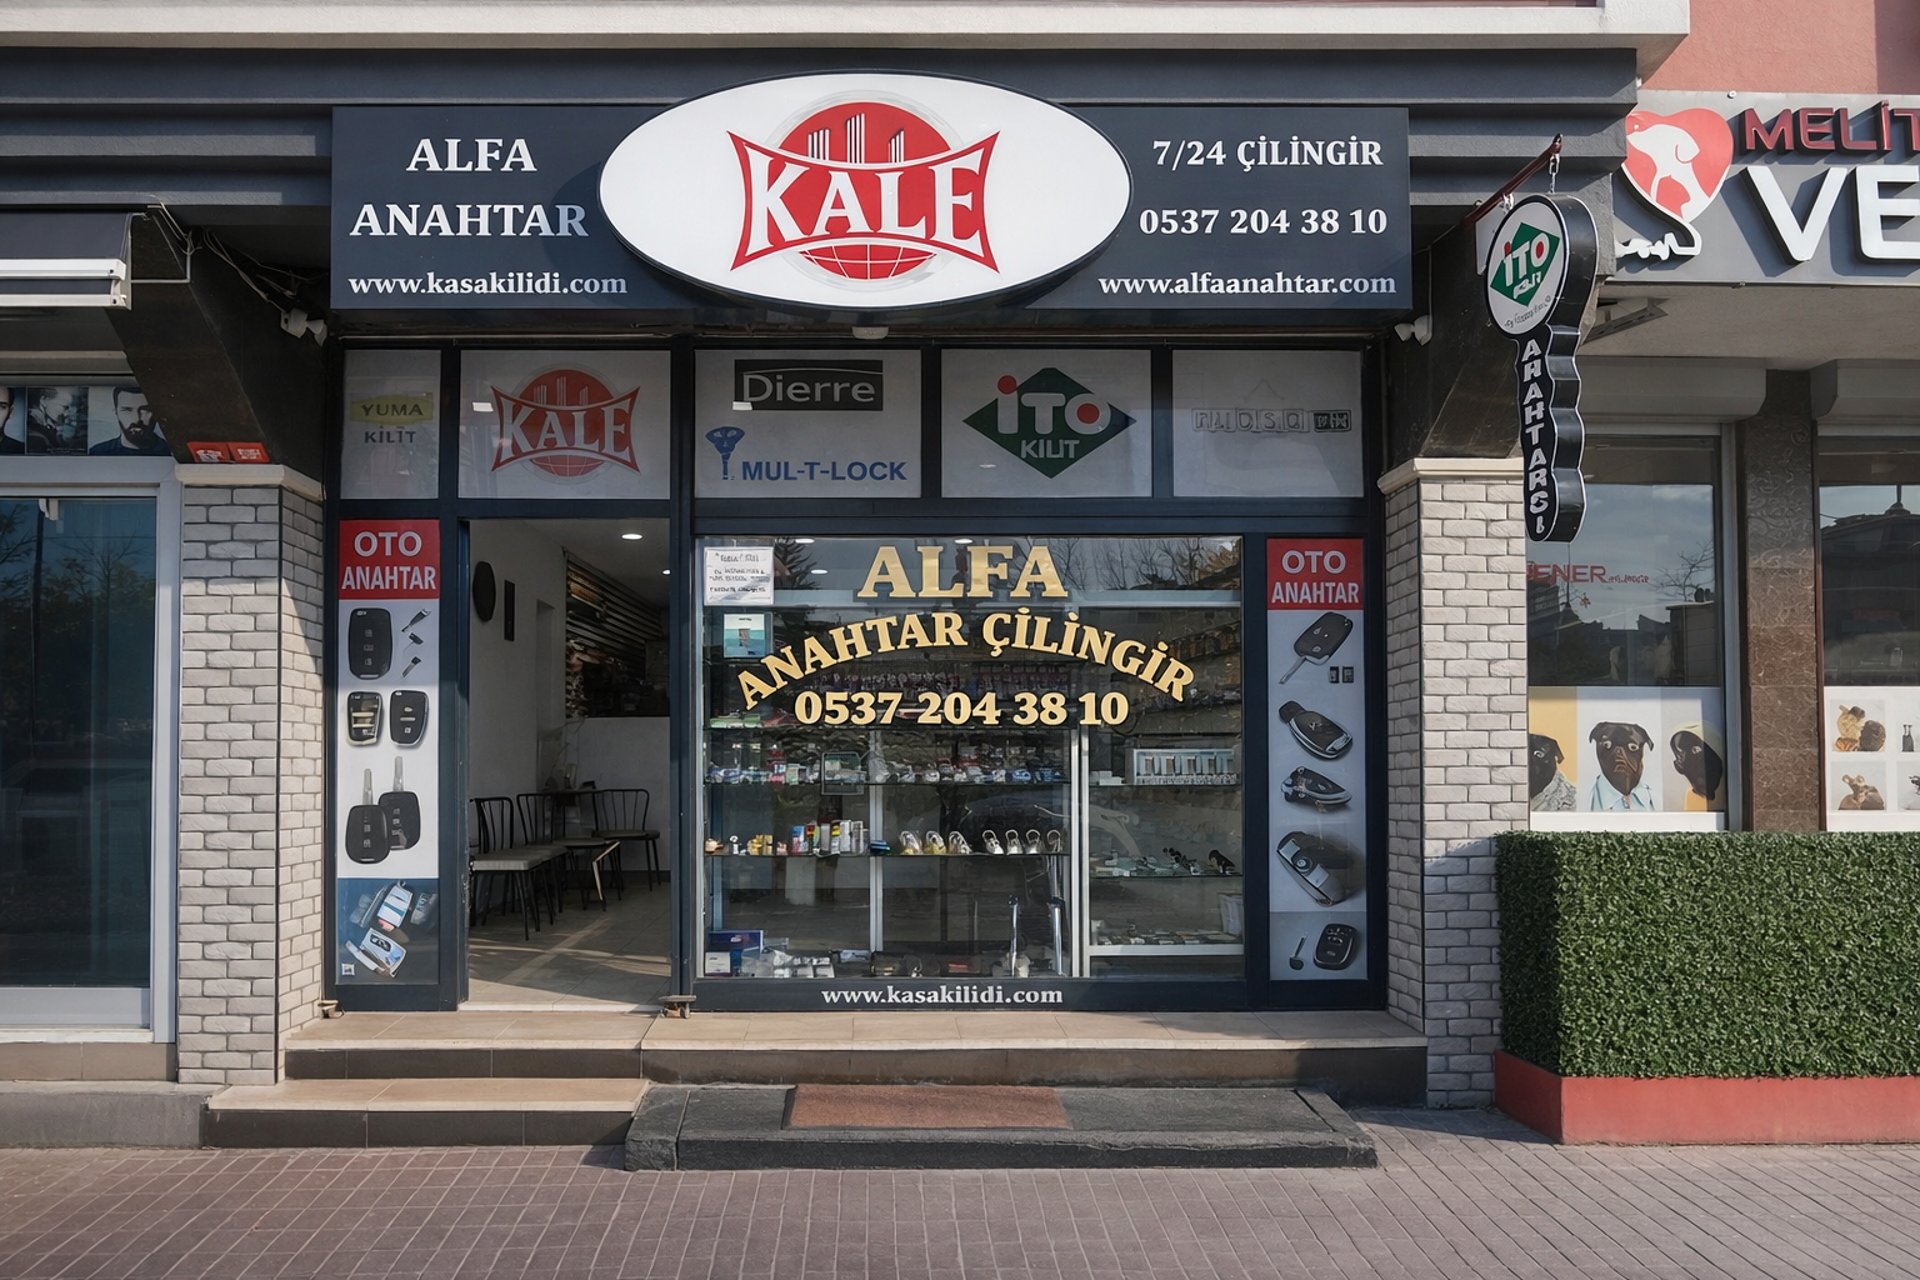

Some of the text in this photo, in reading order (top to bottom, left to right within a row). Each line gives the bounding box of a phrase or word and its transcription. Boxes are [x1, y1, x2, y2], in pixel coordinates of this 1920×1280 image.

[406, 138, 537, 172] ALFA
[1153, 135, 1383, 173] 7/24 ÇİLİNGİR
[743, 142, 985, 257] KALE
[1747, 165, 1920, 261] VE
[349, 204, 589, 237] ANAHTAR
[1139, 209, 1388, 235] 0537 204 38 10
[348, 271, 627, 294] www.kasakilidi.com
[1099, 271, 1396, 295] www.alfaanahtar.com
[743, 374, 876, 402] Dierre
[361, 403, 424, 417] YUMA
[500, 397, 632, 463] KALE
[742, 461, 907, 481] MUL-T-LOCK
[353, 531, 422, 557] OTO
[857, 545, 1069, 600] ALFA
[1281, 550, 1347, 575] OTO
[341, 566, 436, 590] ANAHTAR
[1272, 582, 1359, 604] ANAHTAR
[736, 606, 1195, 710] ANAHTAR ÇİLİNGİR
[795, 691, 1130, 725] 0537 204 38 10
[822, 985, 1063, 1004] www.kasakilidi.com
